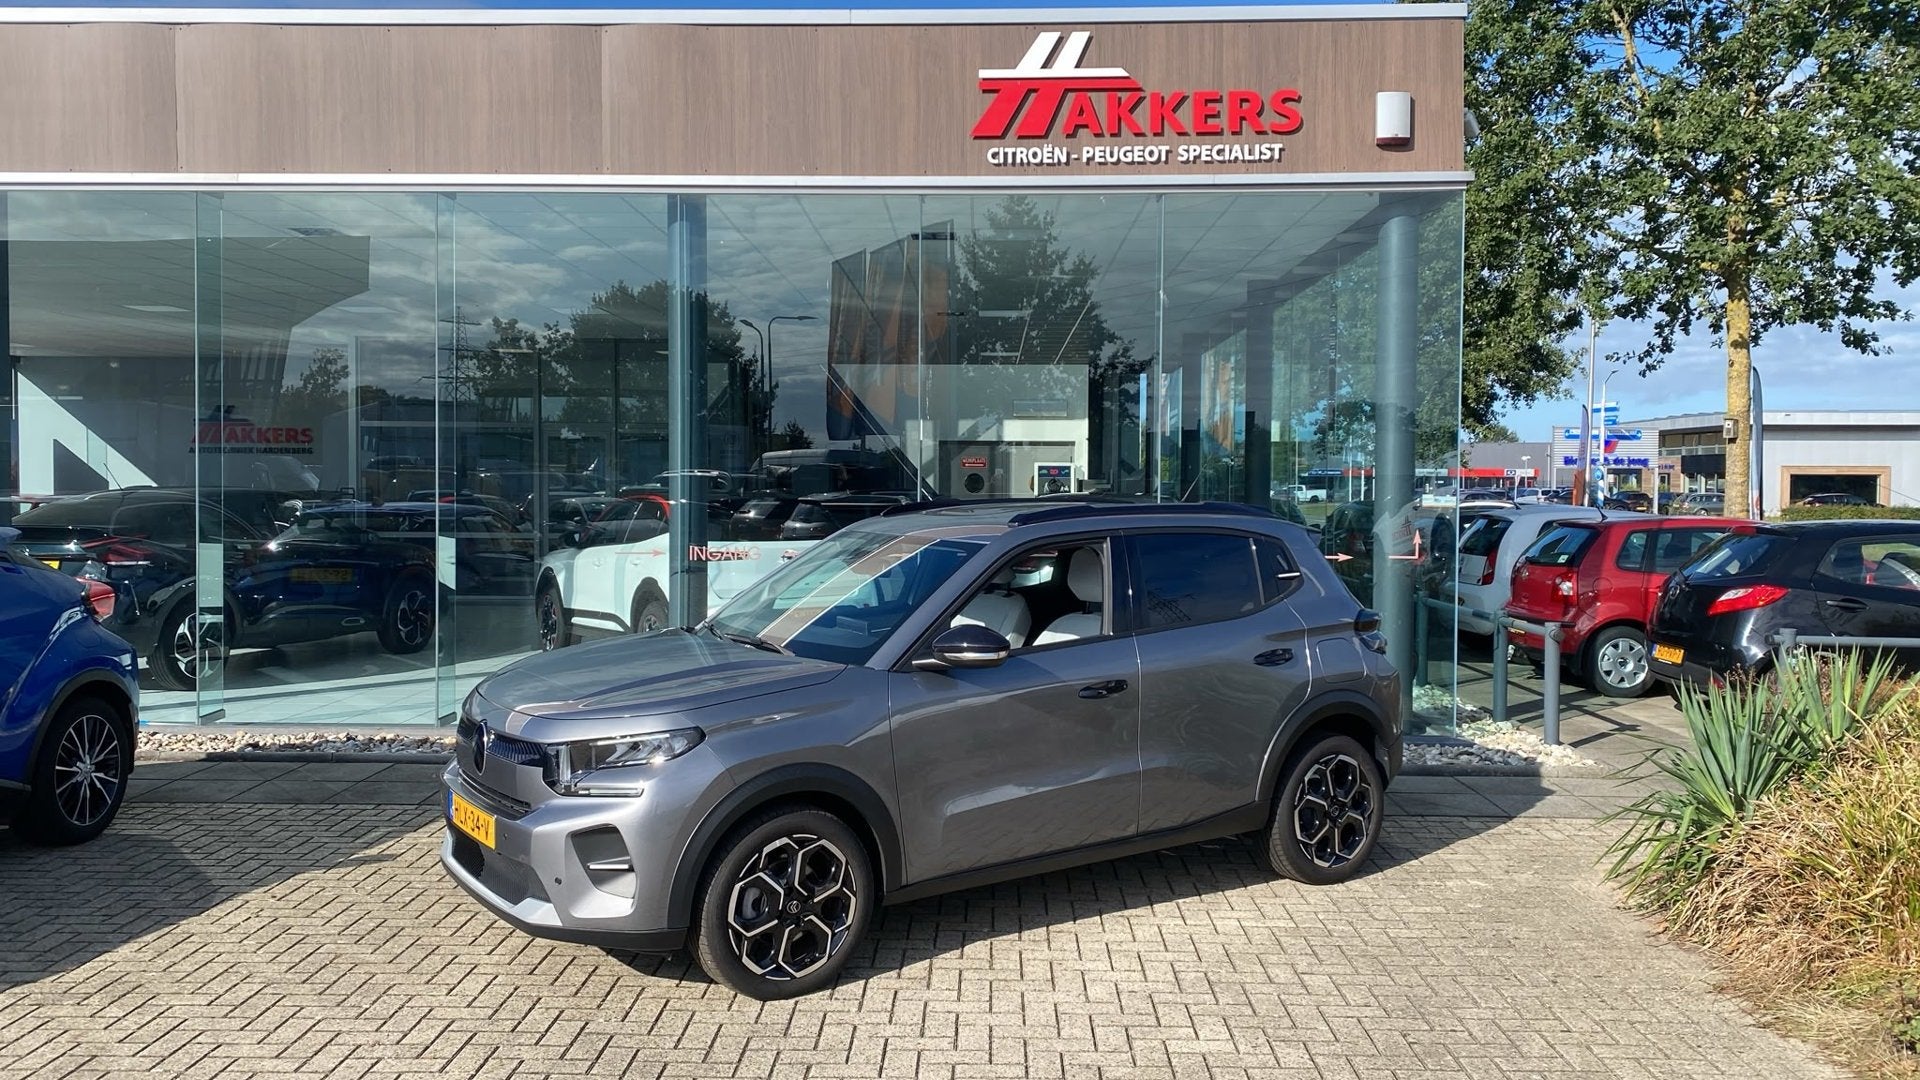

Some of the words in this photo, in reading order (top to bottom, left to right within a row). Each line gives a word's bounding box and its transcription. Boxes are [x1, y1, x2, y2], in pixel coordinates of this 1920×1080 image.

[970, 31, 1304, 138] HAKKERS
[987, 143, 1067, 165] CITROËN
[1081, 144, 1170, 164] PEUGEOT
[1177, 142, 1283, 163] SPECIALIST
[688, 545, 762, 562] INGANG
